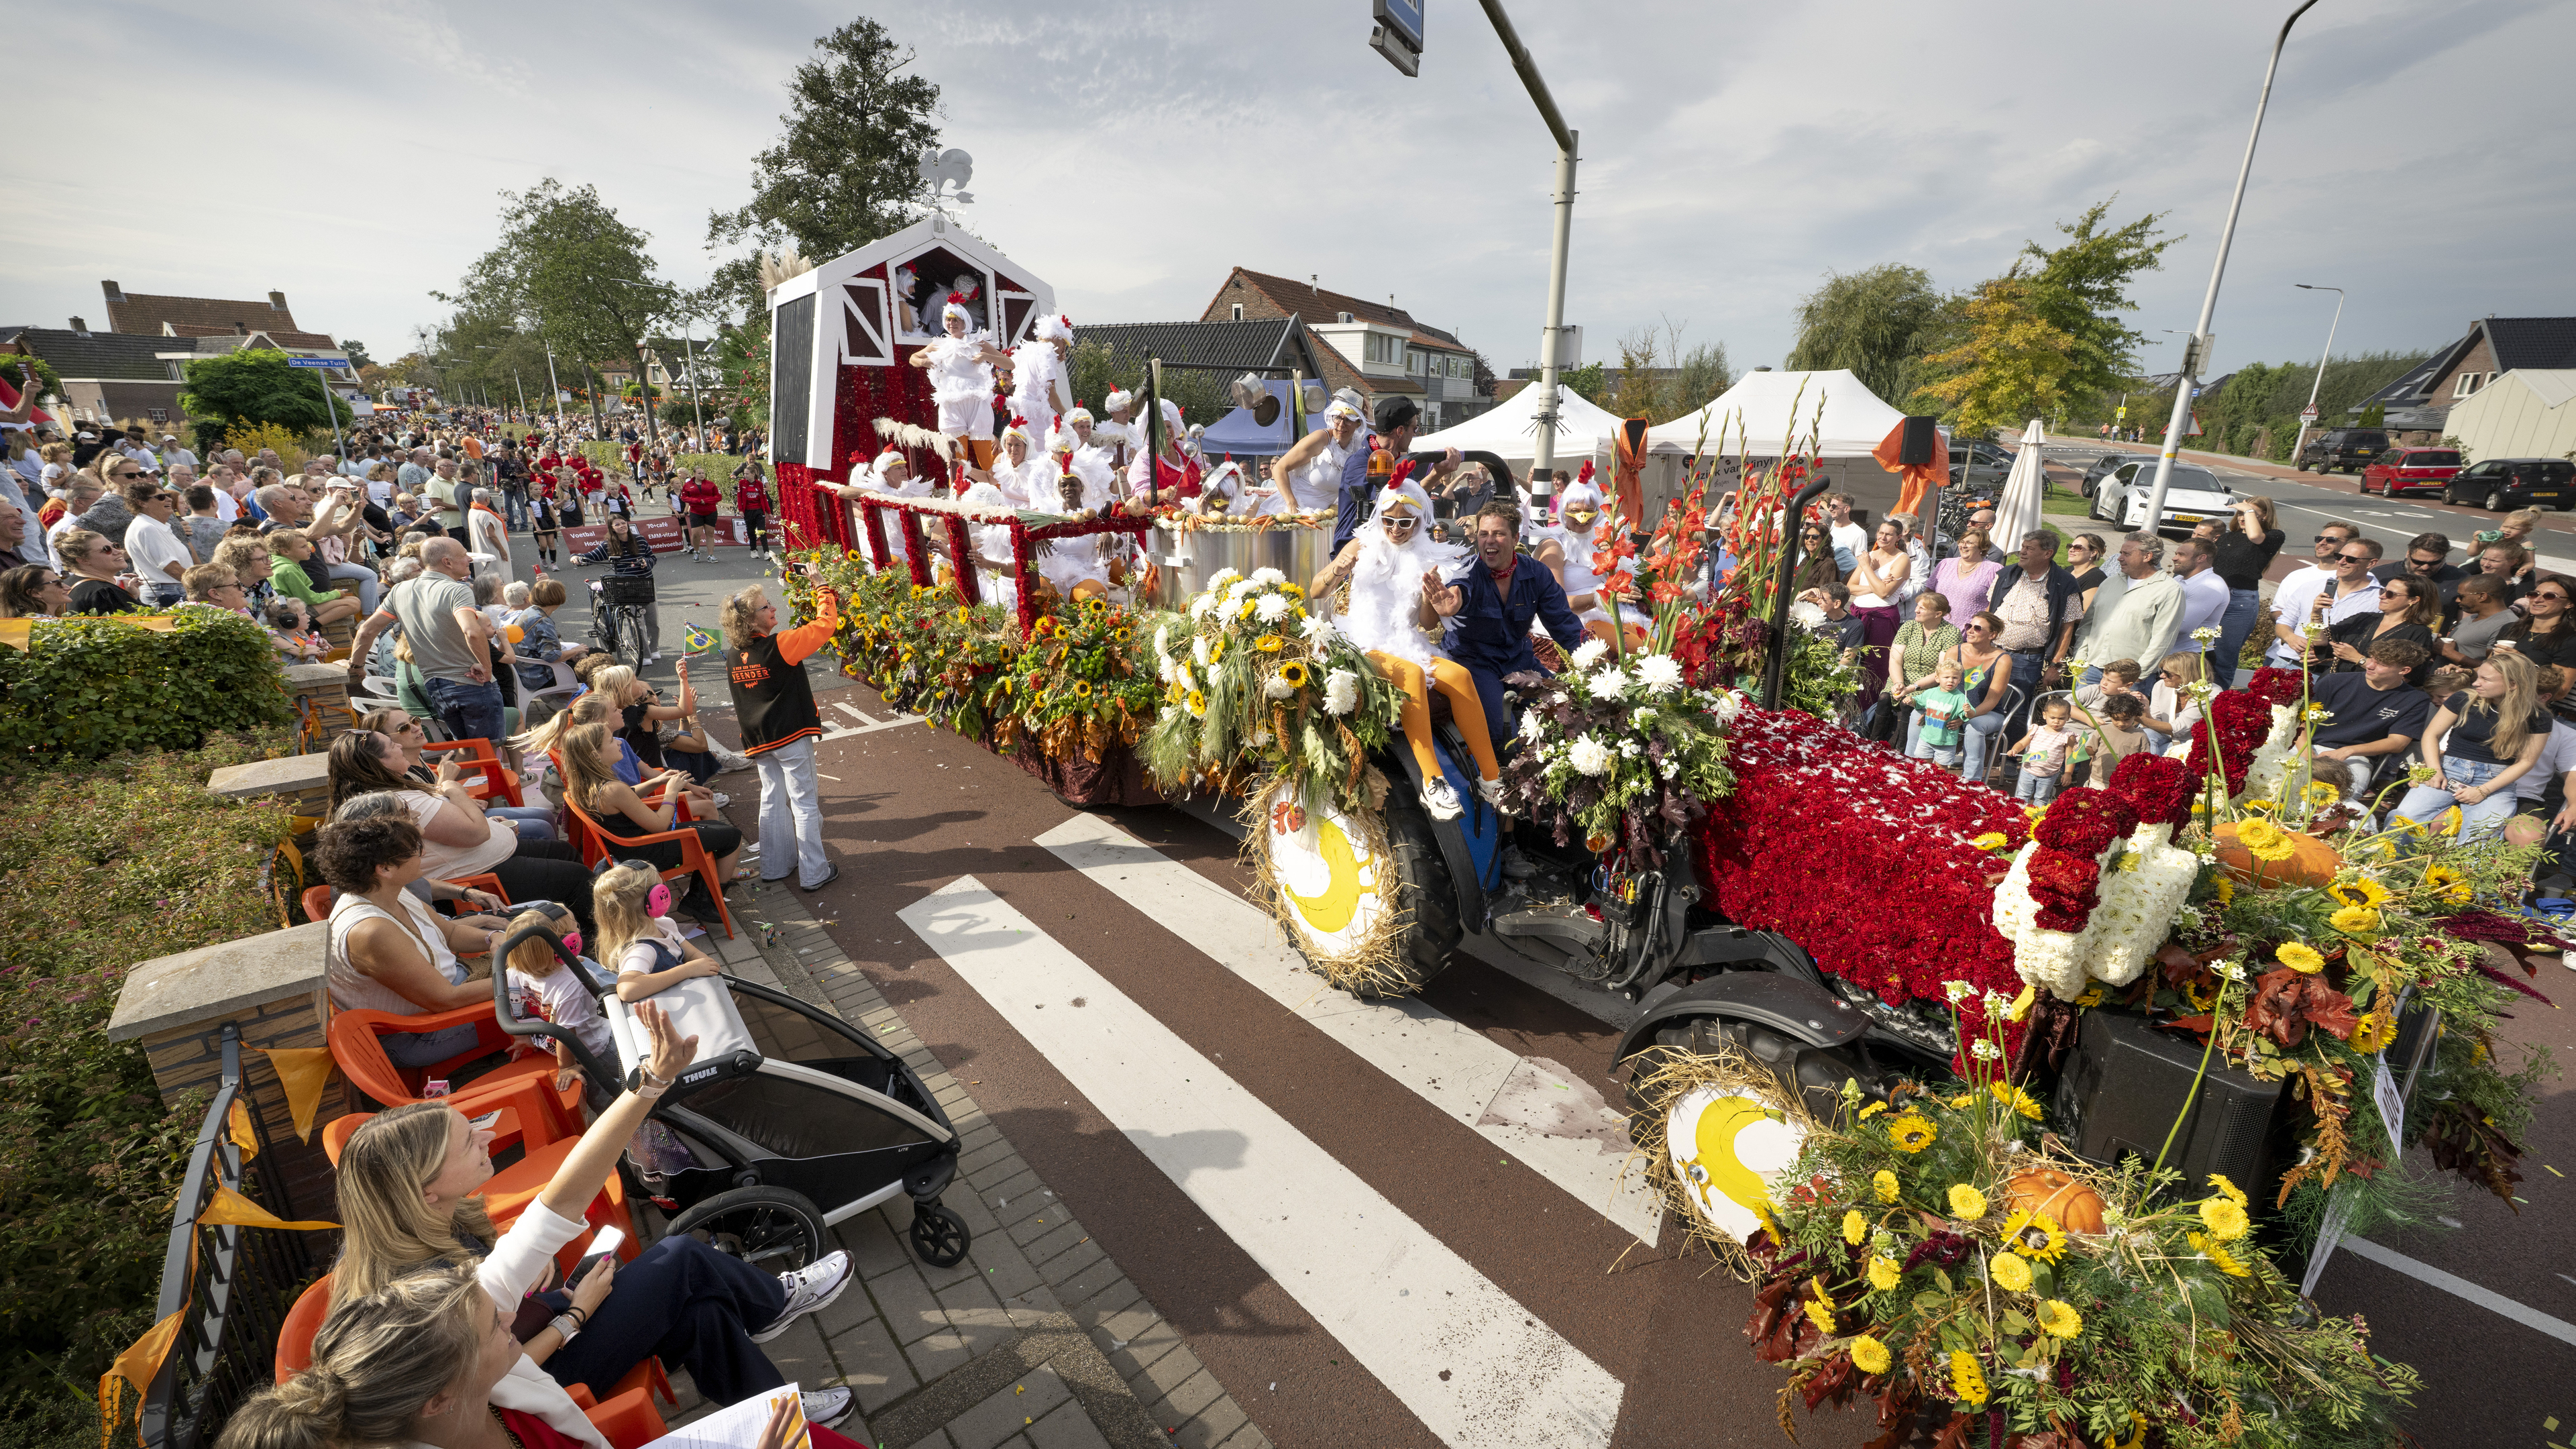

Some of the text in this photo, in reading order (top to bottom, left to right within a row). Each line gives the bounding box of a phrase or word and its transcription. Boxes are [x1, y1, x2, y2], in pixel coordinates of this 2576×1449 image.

[646, 521, 669, 529] 70+café
[570, 531, 596, 539] Voetbal
[647, 531, 679, 539] EMM-vitaal
[649, 540, 684, 549] andelvoetbal
[731, 669, 770, 681] VEENDER
[659, 892, 669, 901] kid
[683, 1066, 718, 1084] THULE
[2382, 1074, 2400, 1134] 406
